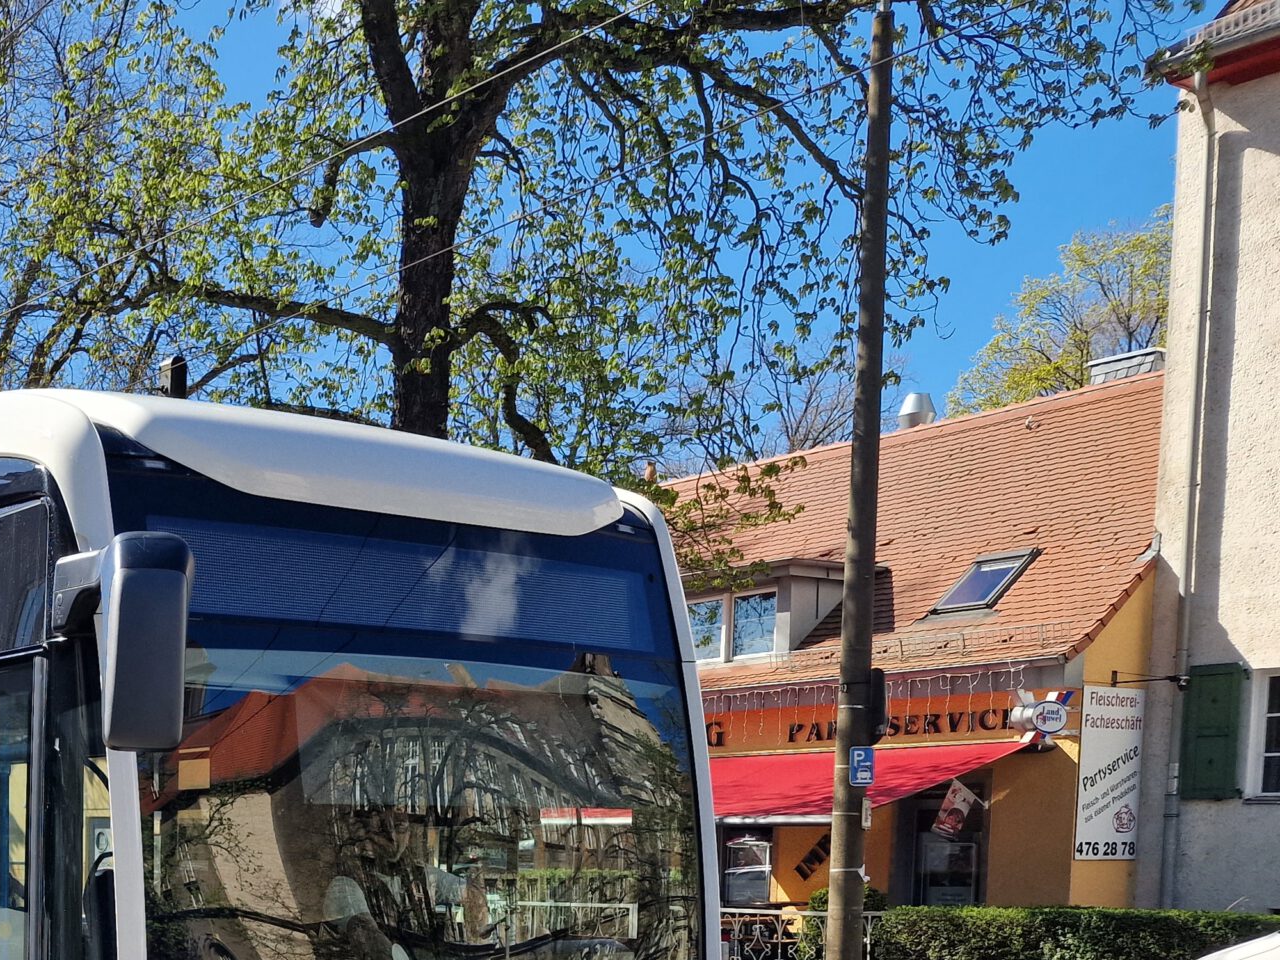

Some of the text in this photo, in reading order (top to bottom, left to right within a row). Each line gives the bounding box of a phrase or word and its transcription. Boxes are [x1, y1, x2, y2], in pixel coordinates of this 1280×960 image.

[1090, 691, 1140, 708] Fleischerei-
[787, 708, 1014, 743] PARSERVICE
[1085, 713, 1142, 731] Fachgeschäft
[853, 751, 864, 767] P
[1082, 745, 1140, 792] Partyservice
[1076, 841, 1136, 857] 476 28 78
